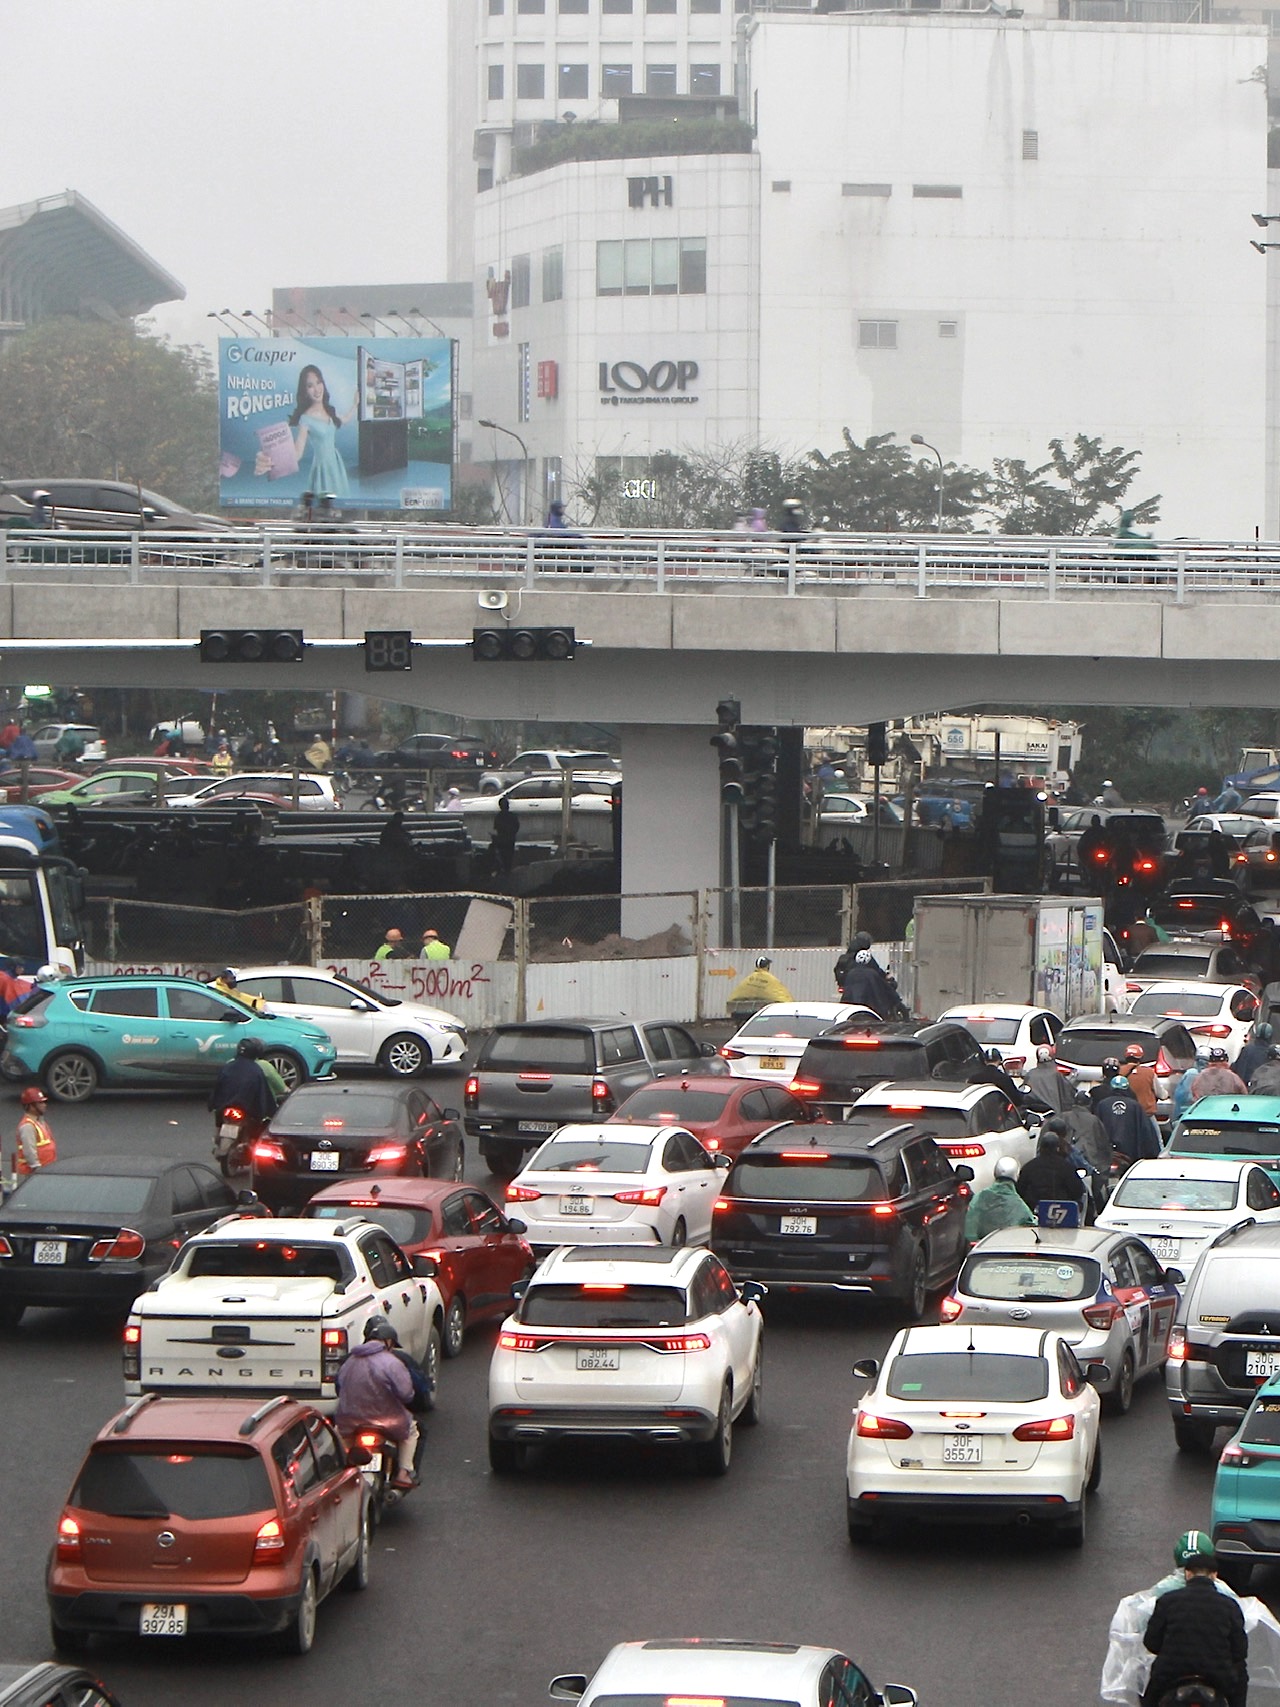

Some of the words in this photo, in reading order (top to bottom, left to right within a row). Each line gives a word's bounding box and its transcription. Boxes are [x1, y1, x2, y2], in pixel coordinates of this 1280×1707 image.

[244, 347, 297, 366] Casper
[599, 360, 699, 392] LOOP
[42, 1242, 59, 1251] 29X
[1157, 1239, 1173, 1248] 29A
[581, 1359, 615, 1368] 082.44
[149, 1366, 314, 1377] RANGER
[952, 1435, 973, 1447] 30F
[944, 1448, 980, 1461] 355.71
[153, 1605, 175, 1618] 29A
[143, 1620, 184, 1633] 397.85
